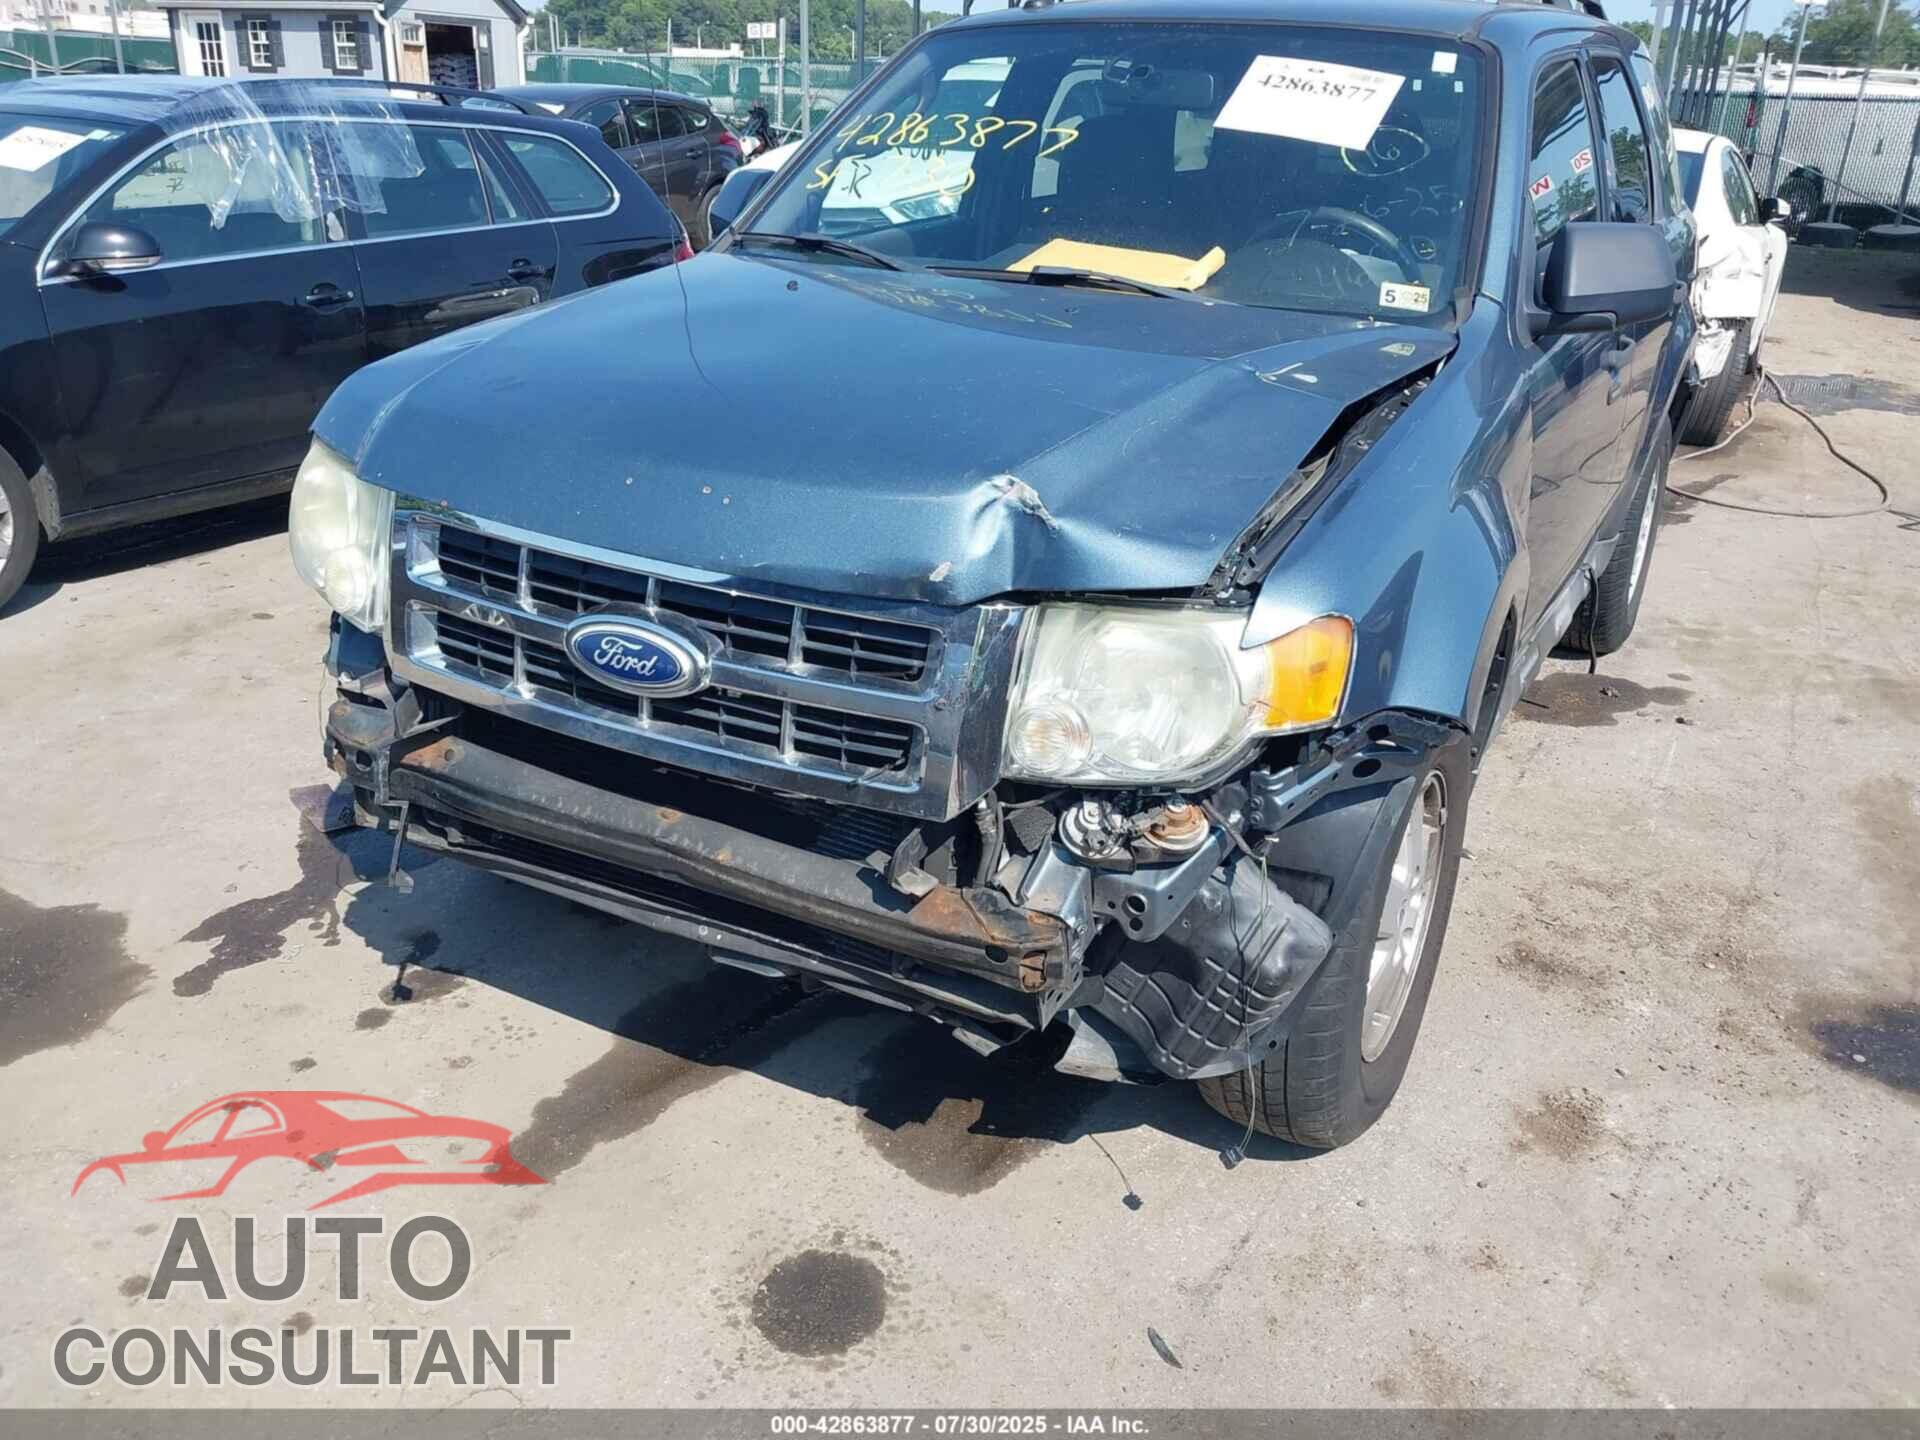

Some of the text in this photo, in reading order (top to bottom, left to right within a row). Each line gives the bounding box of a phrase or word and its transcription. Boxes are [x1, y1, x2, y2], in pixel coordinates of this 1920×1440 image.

[1257, 73, 1377, 103] 42863877
[837, 112, 1079, 158] 42863877
[1384, 289, 1429, 304] 5 25
[594, 636, 658, 676] Ford
